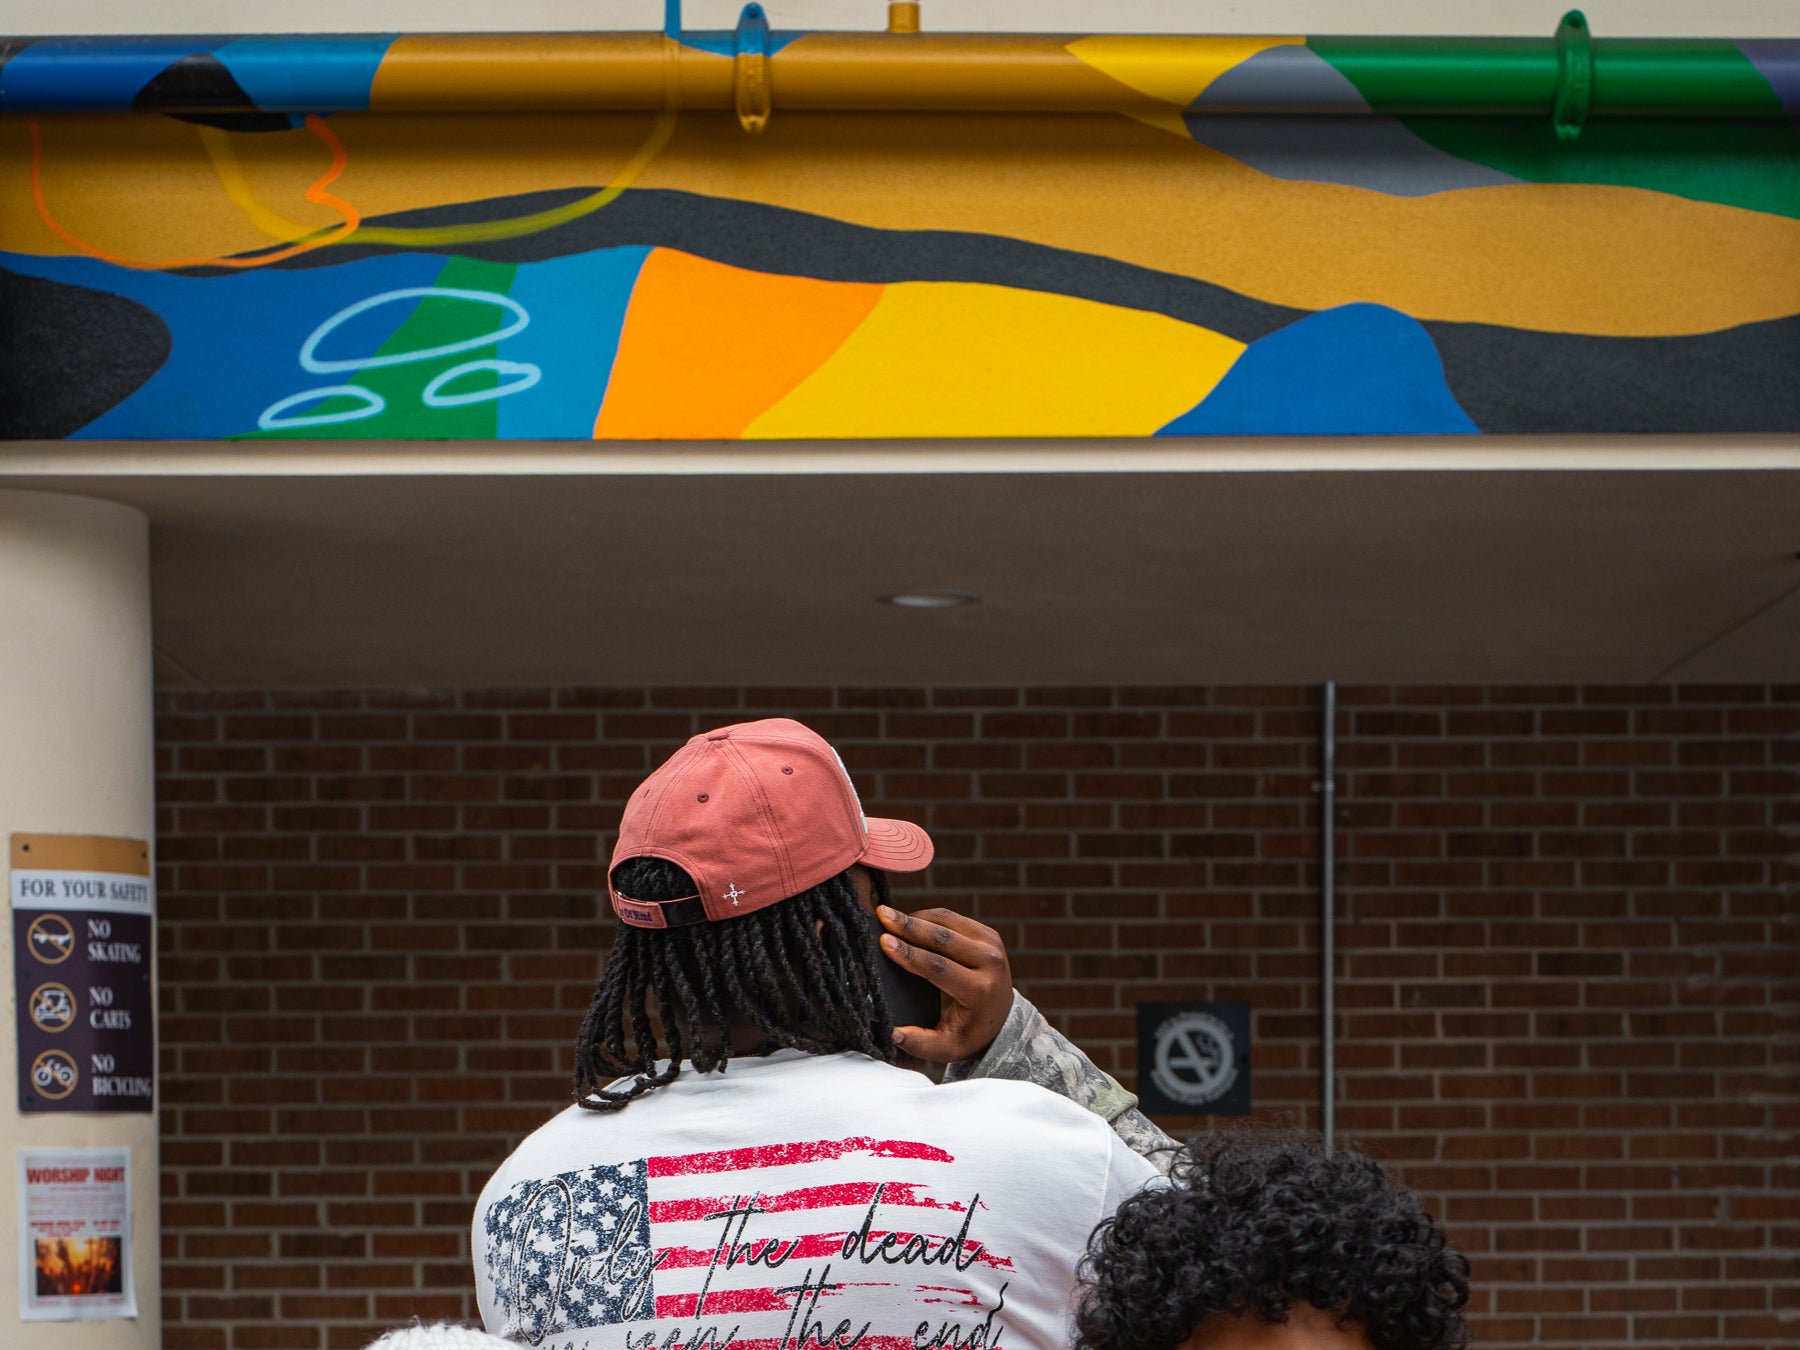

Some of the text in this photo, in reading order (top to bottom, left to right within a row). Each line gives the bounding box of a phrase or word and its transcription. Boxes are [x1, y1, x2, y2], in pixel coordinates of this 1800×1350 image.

[20, 878, 148, 903] FOR YOUR SAFETY
[87, 919, 111, 939] NO
[88, 942, 141, 963] SKATING
[89, 986, 114, 1007] NO
[90, 1009, 132, 1030] CARTS
[91, 1054, 115, 1074] NO
[92, 1076, 152, 1097] BICYCLING
[27, 1168, 91, 1184] WORSHIP
[510, 1177, 669, 1347] Only
[842, 1182, 983, 1272] dead
